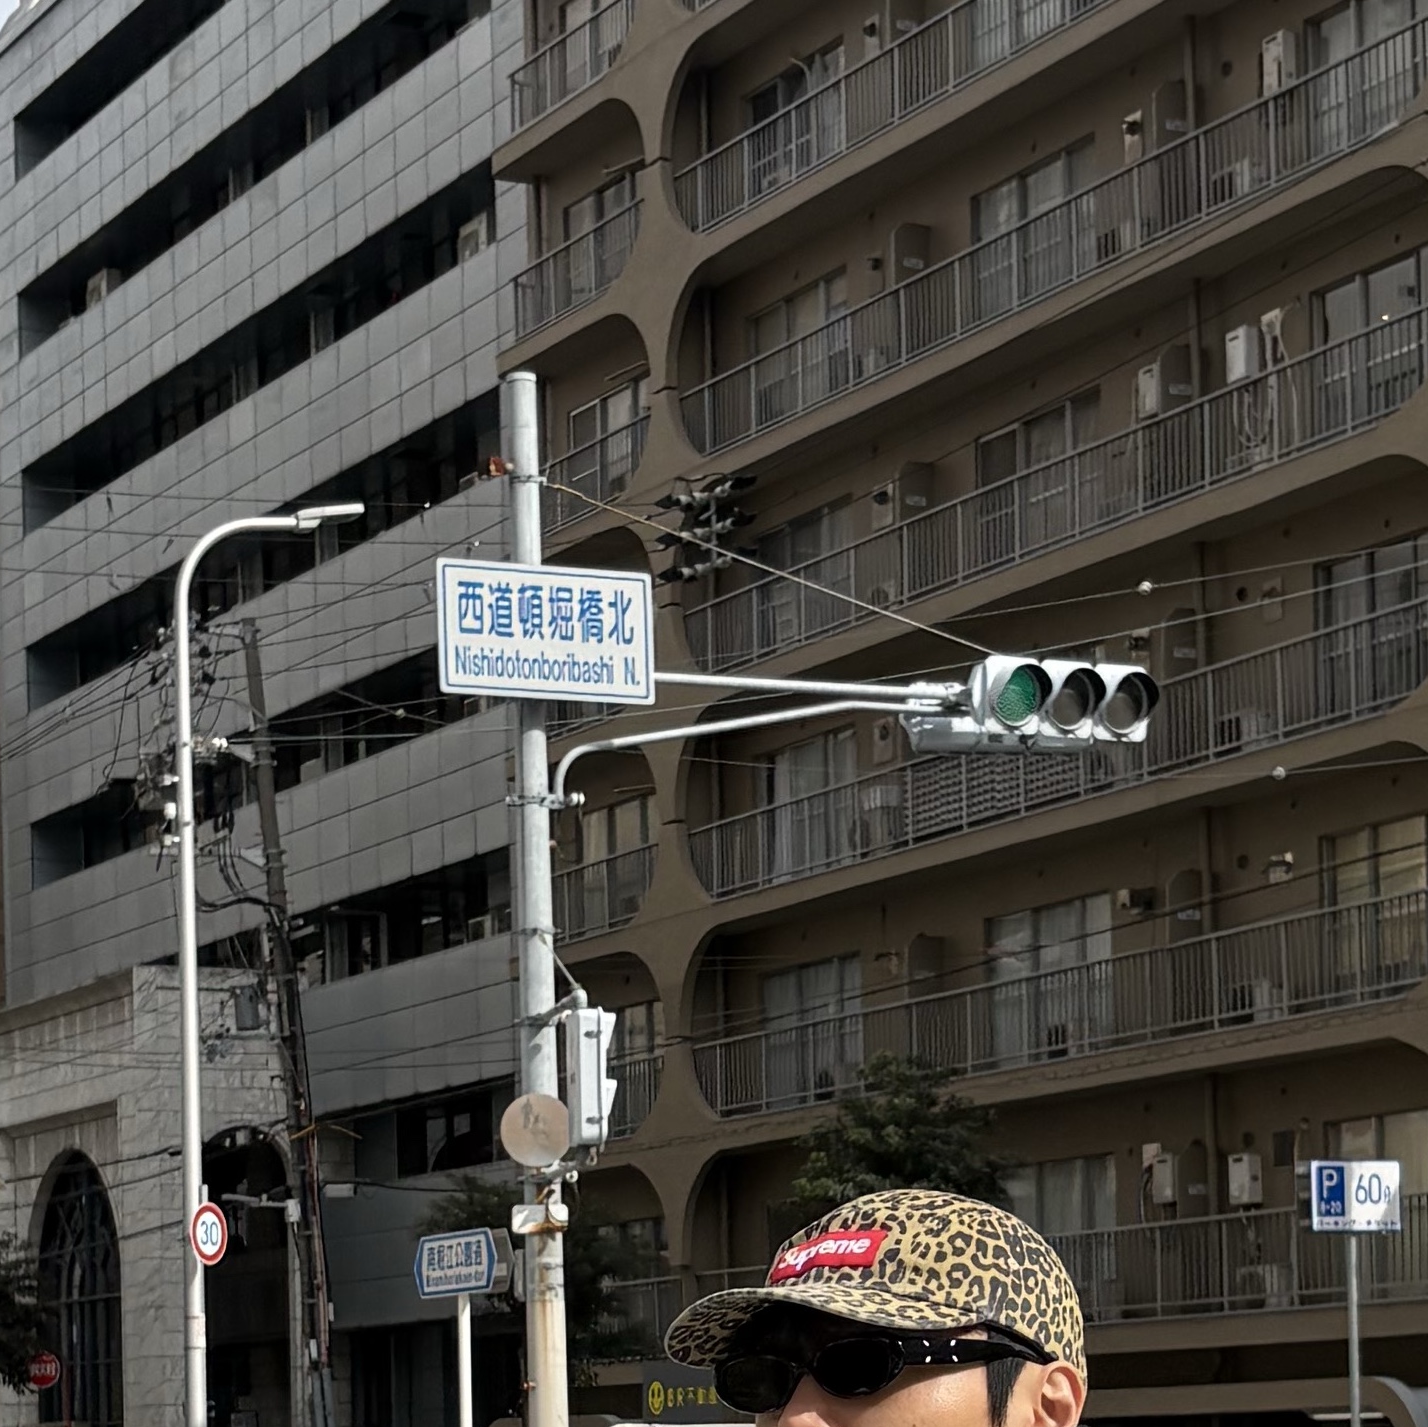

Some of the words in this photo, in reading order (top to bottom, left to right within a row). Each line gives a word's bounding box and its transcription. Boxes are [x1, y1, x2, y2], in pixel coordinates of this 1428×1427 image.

[456, 580, 635, 646] 西道頓堀橋北
[454, 645, 614, 685] Nishidotonboribashi
[623, 656, 641, 687] N.
[1321, 1168, 1338, 1199] P
[200, 1220, 219, 1246] 30
[778, 1238, 872, 1271] Supreme
